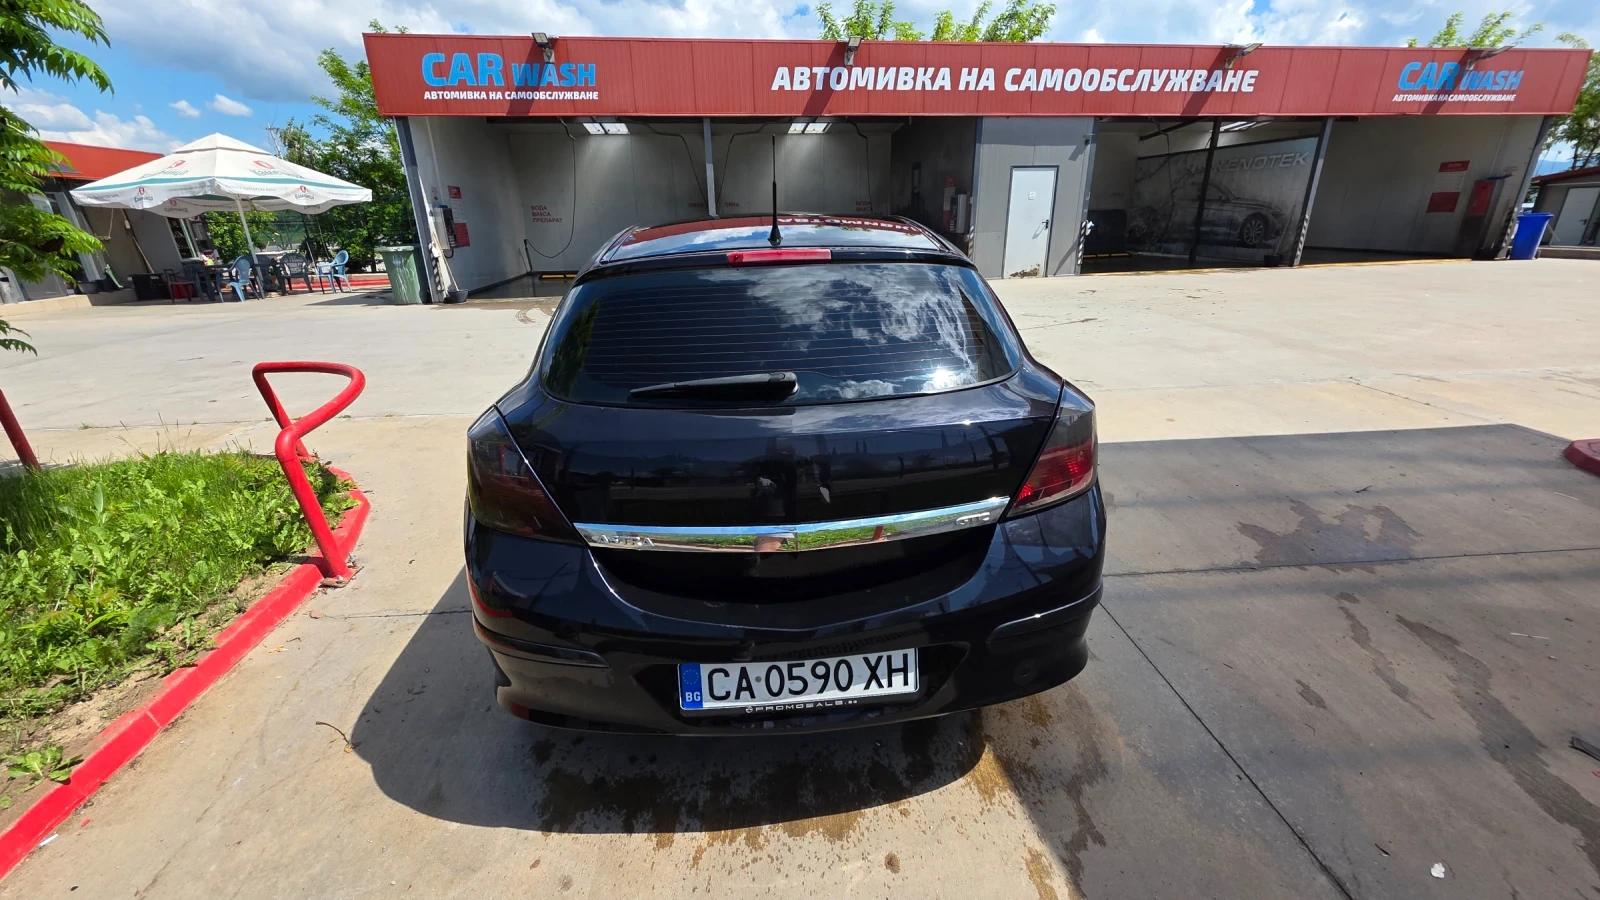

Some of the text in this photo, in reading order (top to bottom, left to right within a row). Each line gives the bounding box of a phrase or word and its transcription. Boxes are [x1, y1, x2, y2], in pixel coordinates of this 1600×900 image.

[421, 52, 596, 87] CAR WASH
[770, 66, 1259, 93] АВТОМИВКА НА САМООБСЛУЖВАНЕ
[1398, 62, 1523, 90] CAR WASH
[423, 91, 599, 100] АВТОМИВКА НА САМООБСЛУЖВАНЕ
[1212, 151, 1310, 173] KENOTEK
[956, 511, 990, 525] GTC
[597, 534, 655, 547] ASTRA
[707, 653, 909, 700] CA 0590 XH
[685, 691, 700, 702] BG
